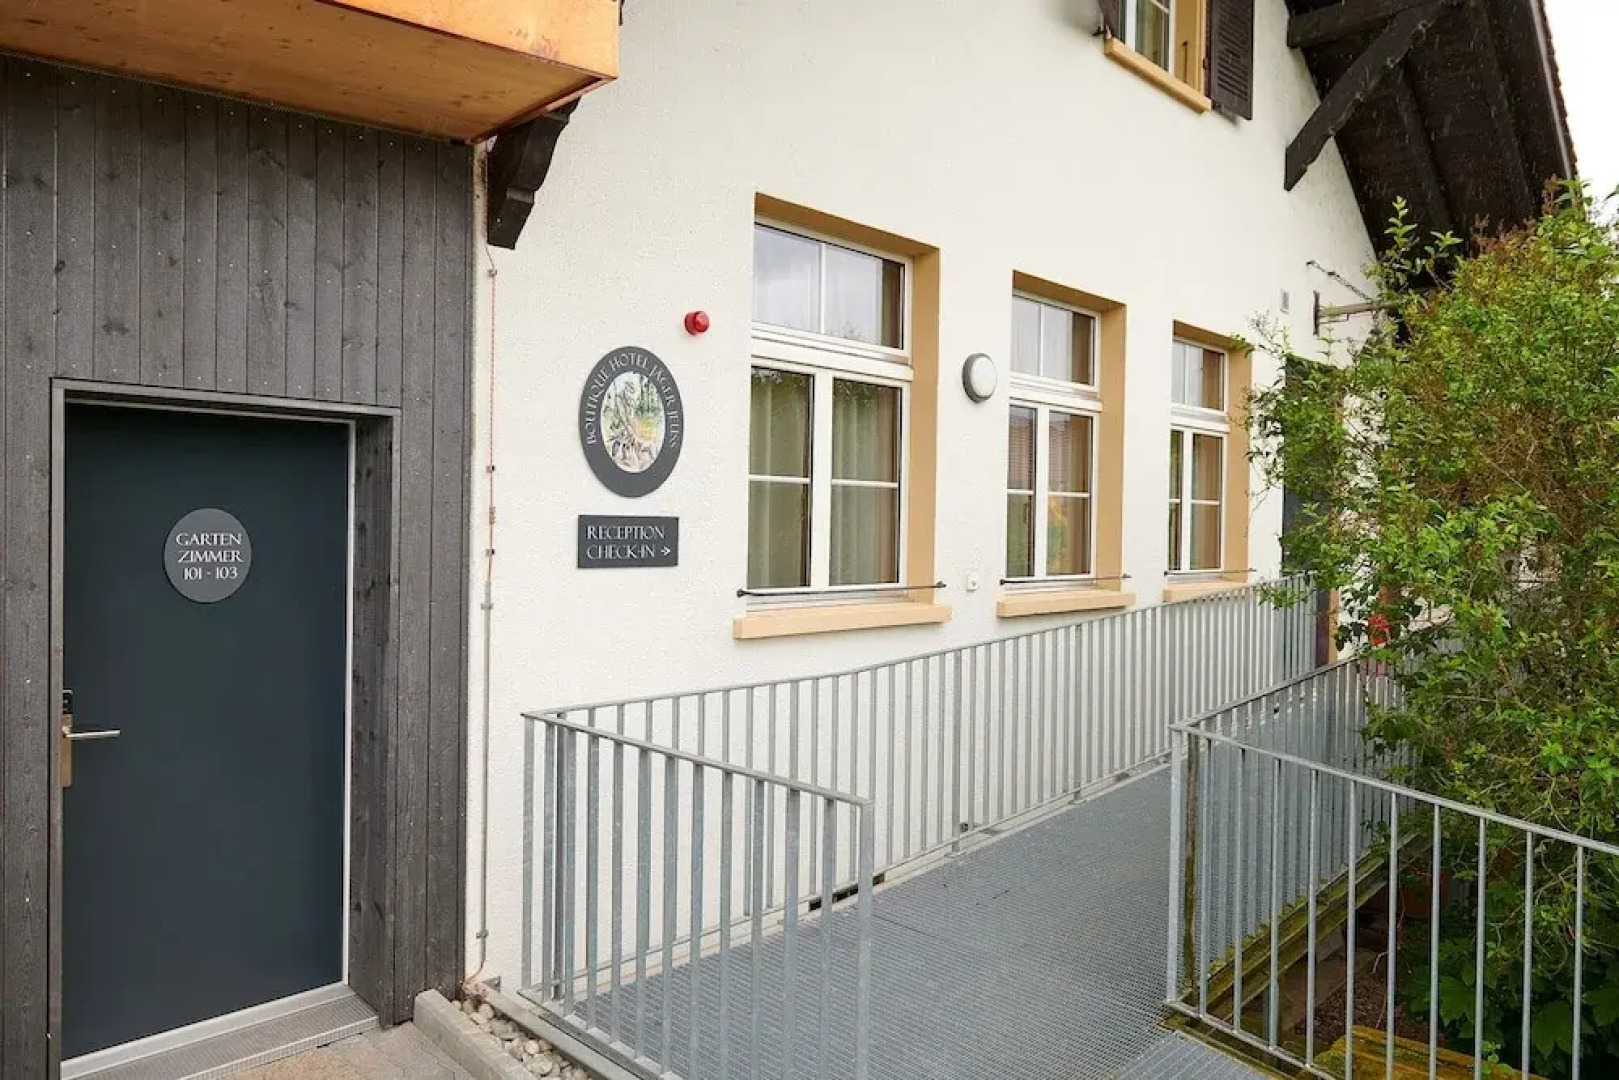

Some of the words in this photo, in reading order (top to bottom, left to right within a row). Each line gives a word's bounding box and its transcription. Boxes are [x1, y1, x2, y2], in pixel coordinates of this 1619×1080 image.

[585, 366, 610, 445] BOUTIQUE
[609, 352, 649, 372] HOTEL
[176, 532, 242, 546] GARTEN
[587, 525, 665, 540] RECEPTION
[178, 550, 243, 563] ZIMMER
[586, 544, 655, 560] CHECK-IN
[184, 567, 202, 580] 101
[216, 566, 238, 579] 103
